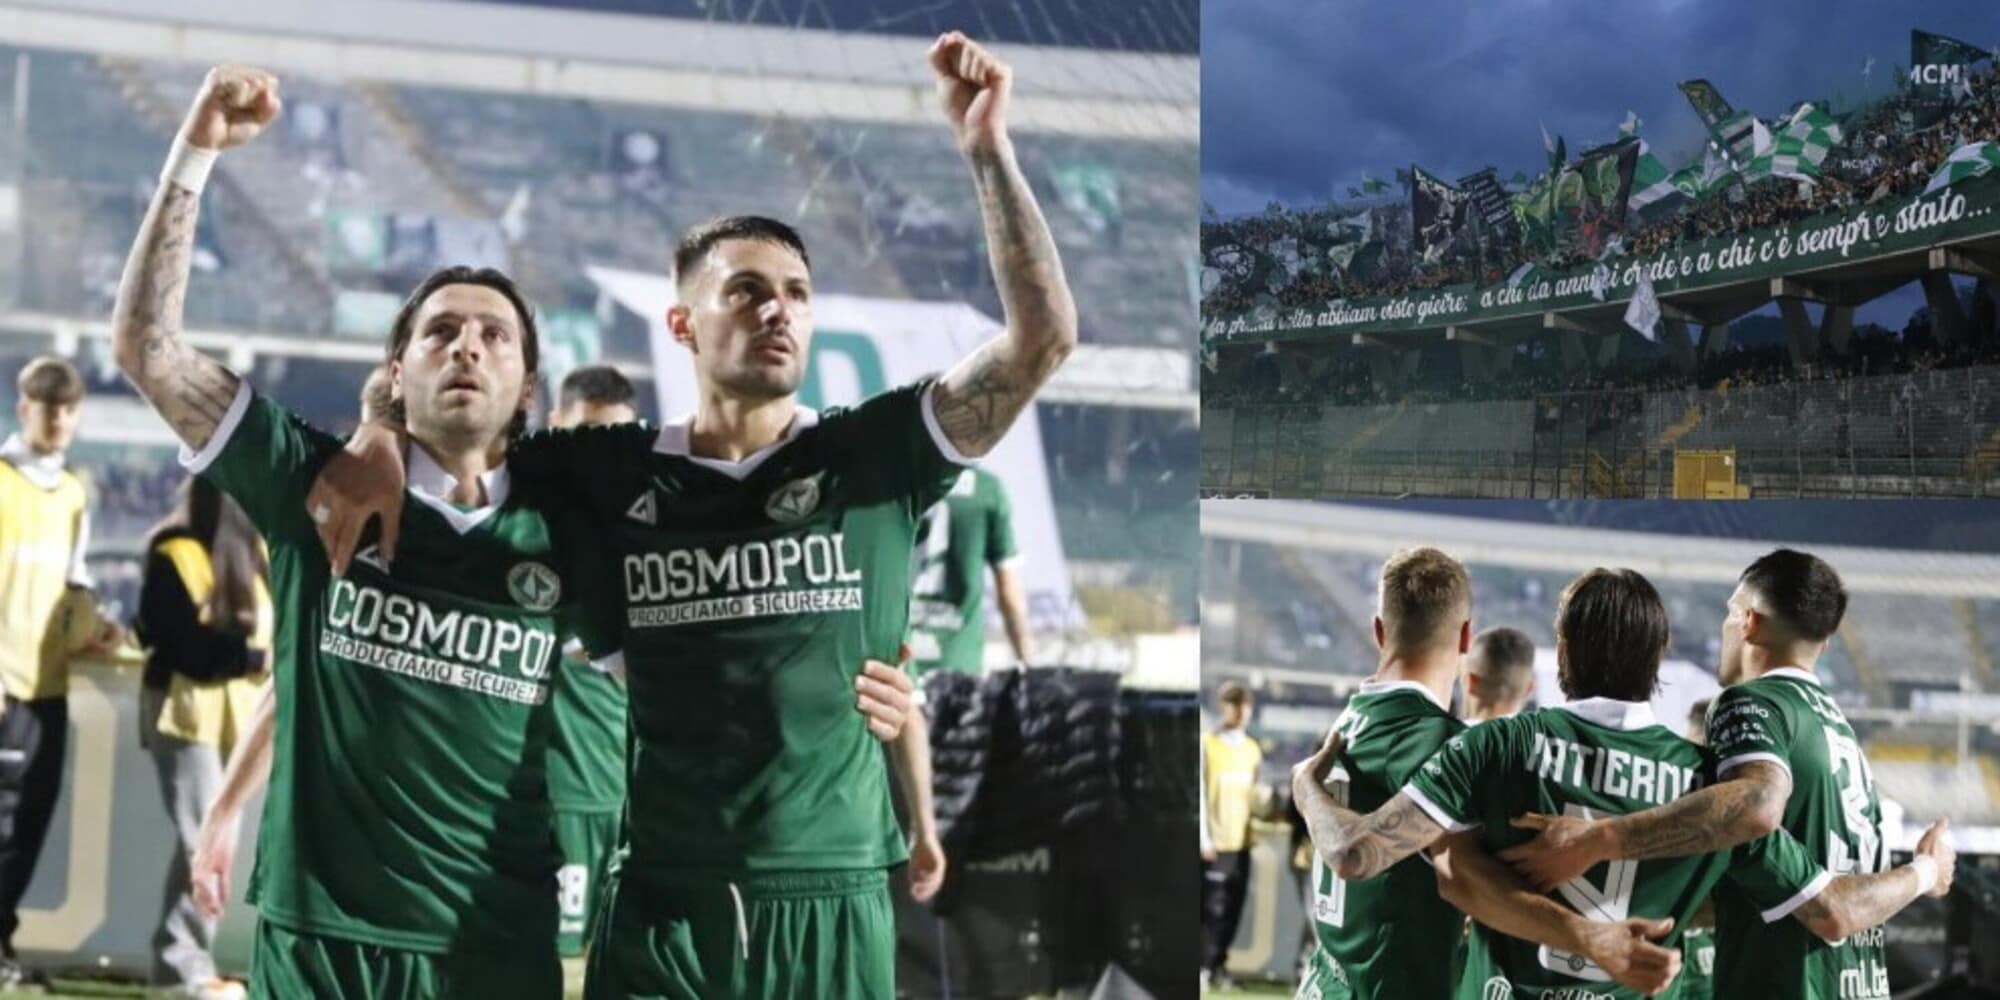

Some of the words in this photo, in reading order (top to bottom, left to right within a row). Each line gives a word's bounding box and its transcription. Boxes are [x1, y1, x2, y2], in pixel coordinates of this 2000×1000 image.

[1480, 290, 1494, 309] a
[1526, 275, 1552, 302] da
[1623, 252, 1678, 287] crde
[1696, 251, 1714, 273] a
[1717, 238, 1757, 270] chi
[623, 533, 863, 602] COSMOPOL
[327, 579, 556, 679] COSMOPOL
[628, 600, 744, 626] PRODUCIAMO
[753, 590, 862, 614] SICUREZZA
[321, 631, 452, 683] PRODUCIAMO
